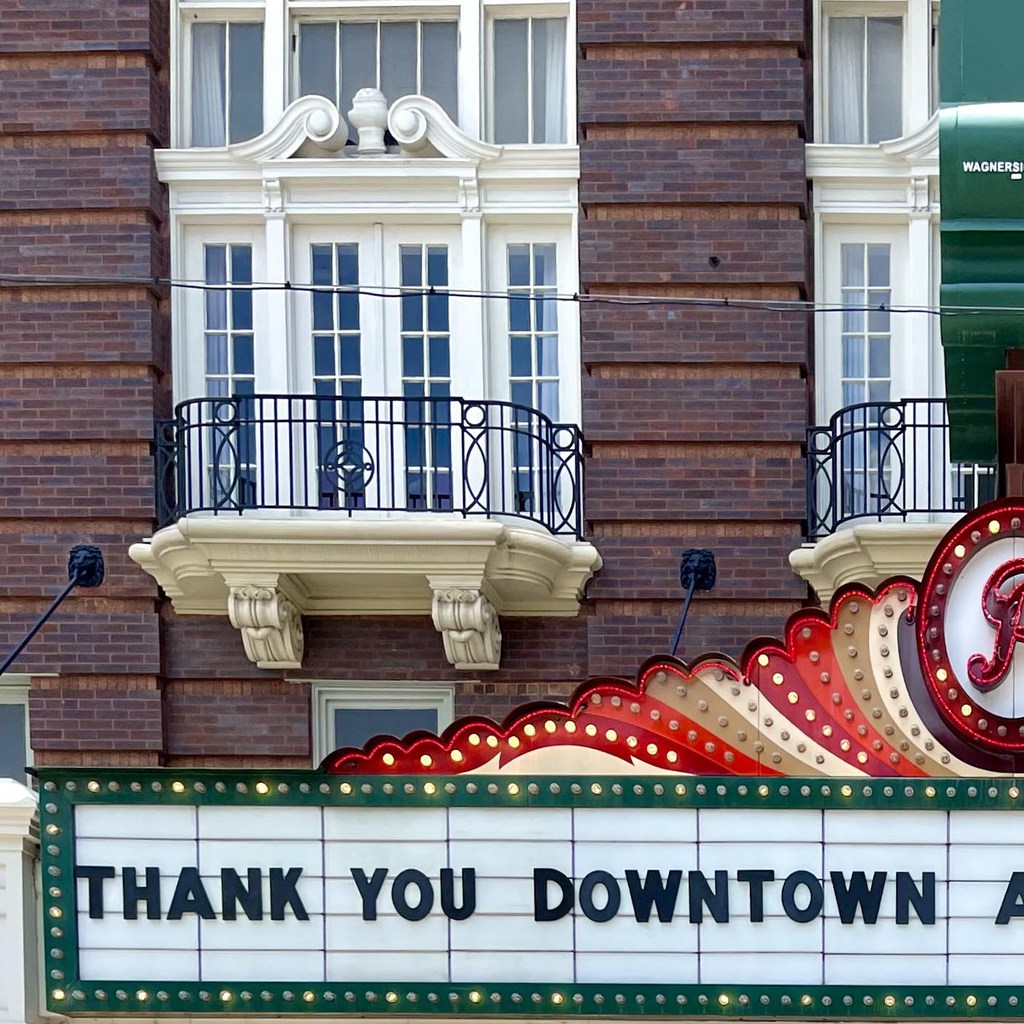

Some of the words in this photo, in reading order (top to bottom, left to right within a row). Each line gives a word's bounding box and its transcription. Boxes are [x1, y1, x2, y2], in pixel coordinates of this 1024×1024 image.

[76, 865, 310, 921] THANK
[350, 867, 477, 922] YOU
[533, 867, 936, 926] DOWNTOWN
